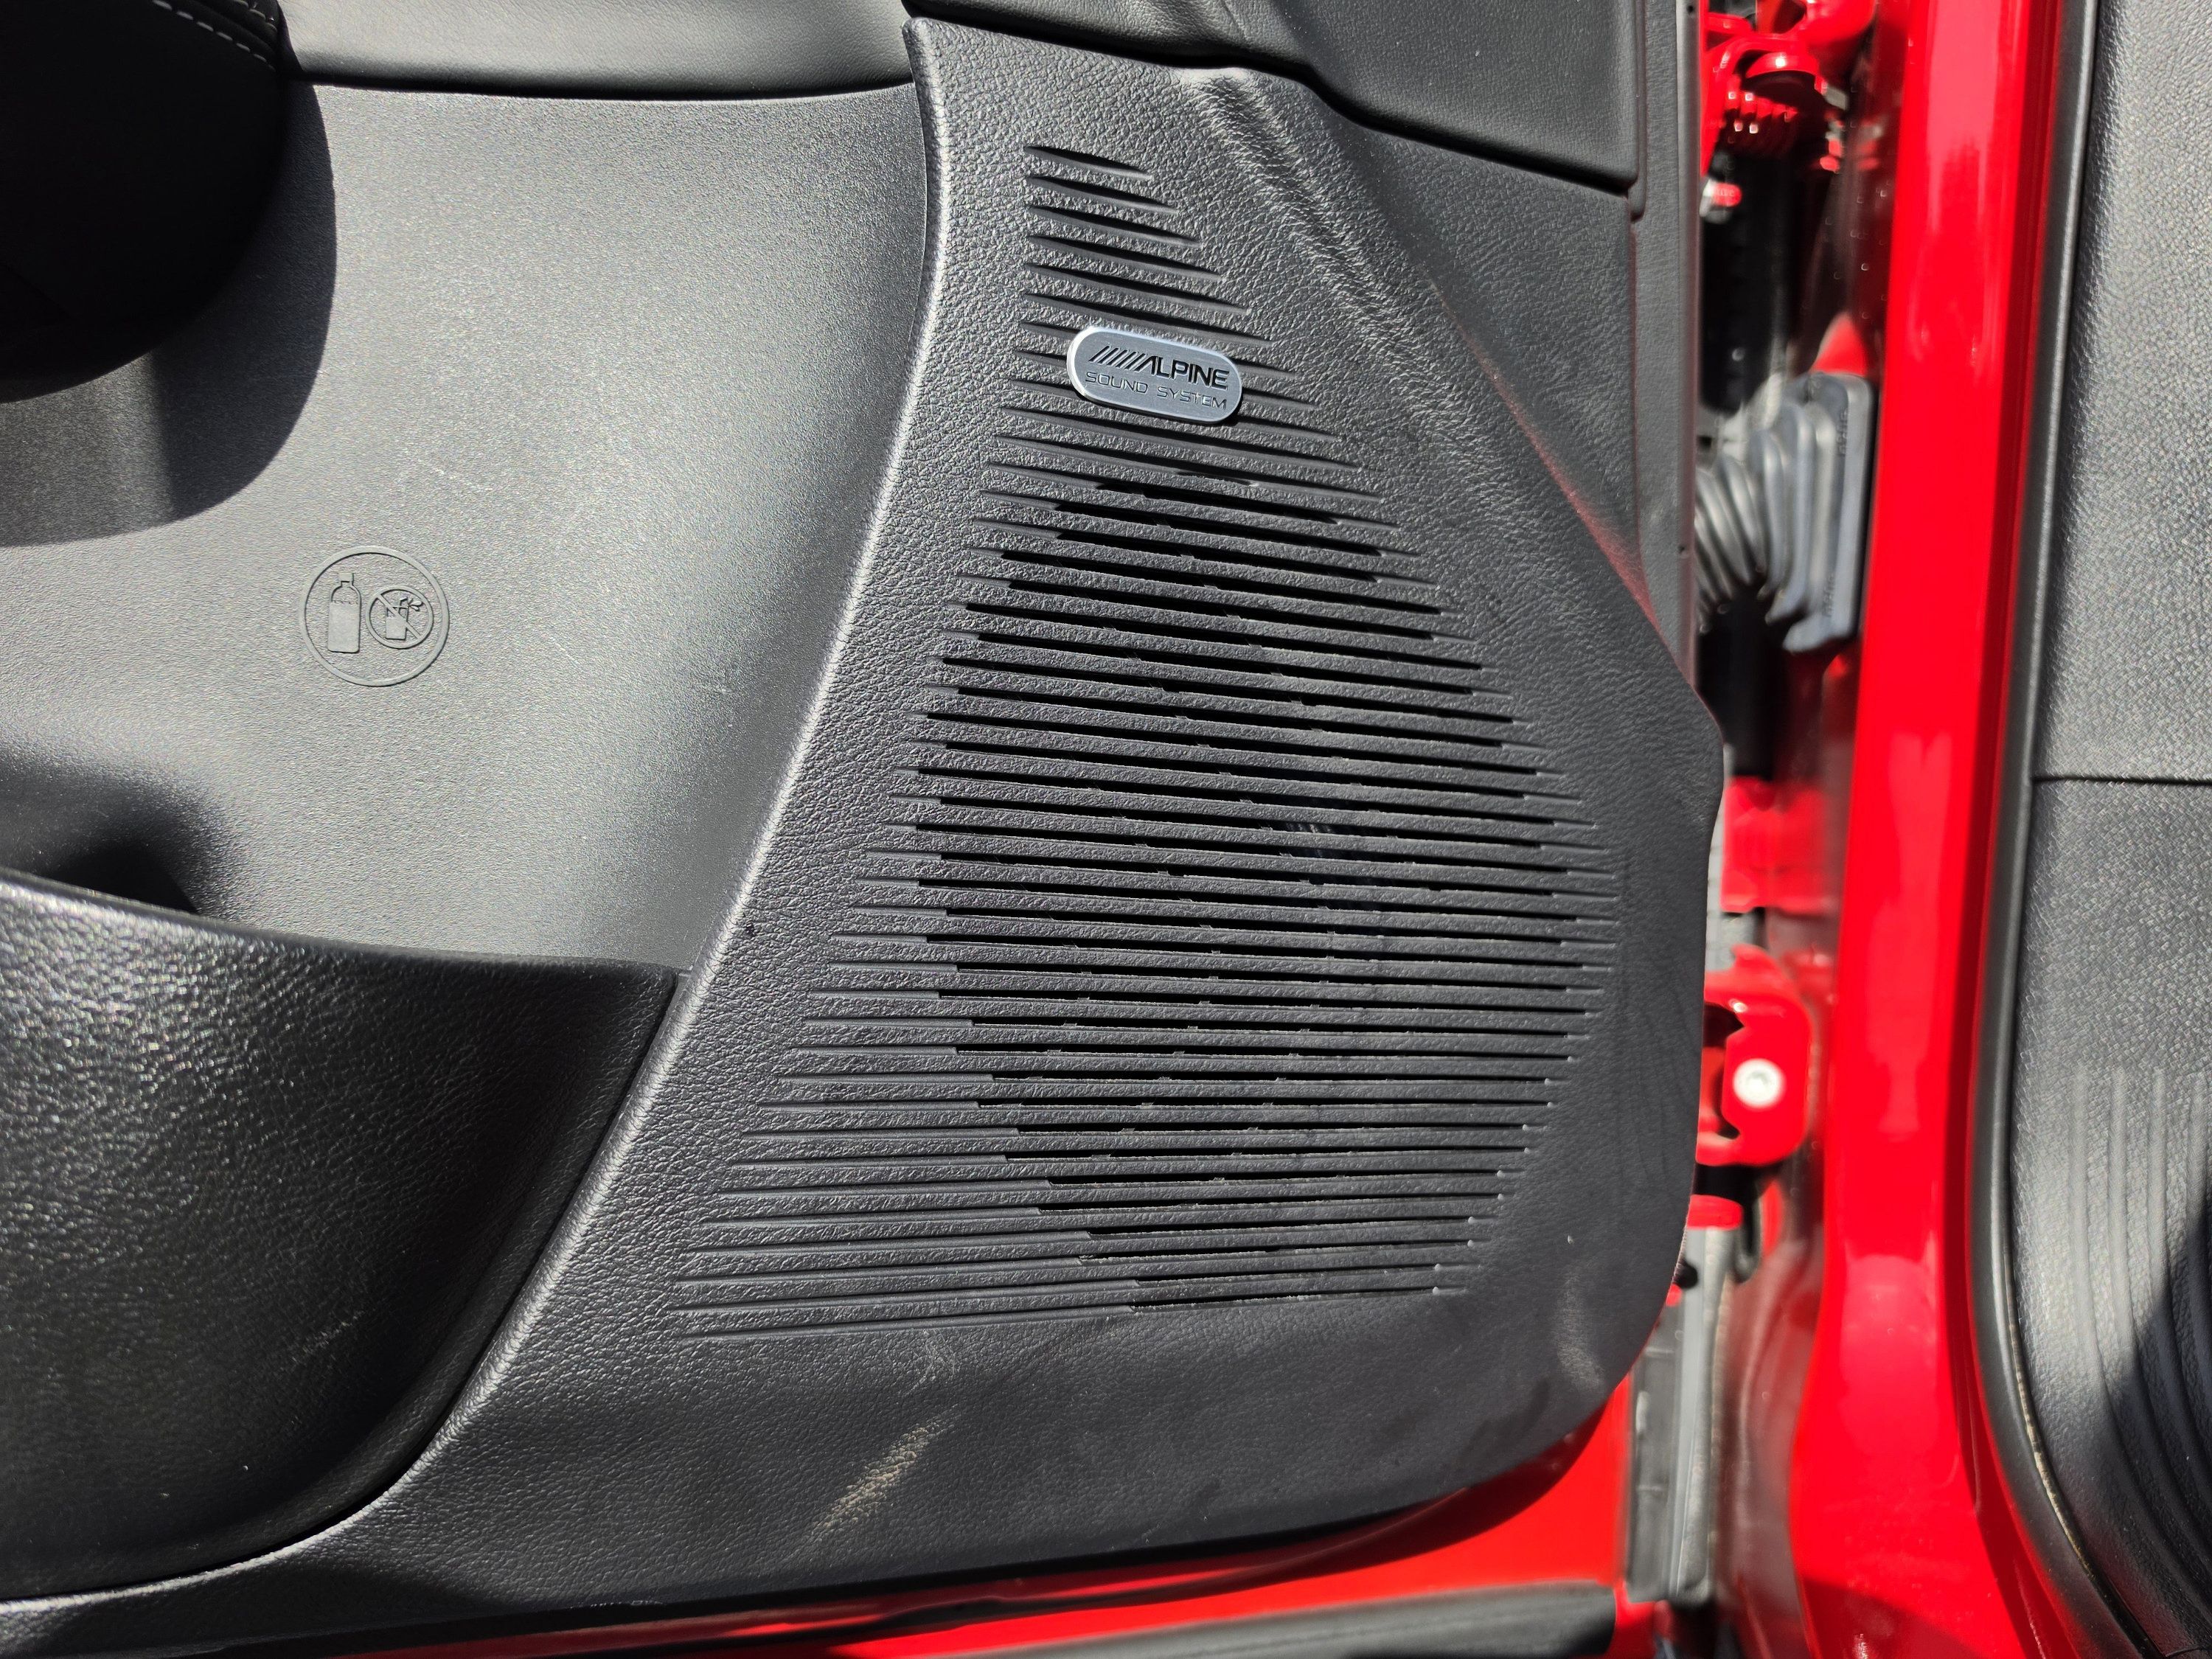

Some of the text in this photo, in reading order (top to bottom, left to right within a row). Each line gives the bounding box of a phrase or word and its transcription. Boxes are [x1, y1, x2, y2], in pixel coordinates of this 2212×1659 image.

[1085, 371, 1228, 410] SOUND SYSTEM
[1133, 355, 1230, 391] ALPINE
